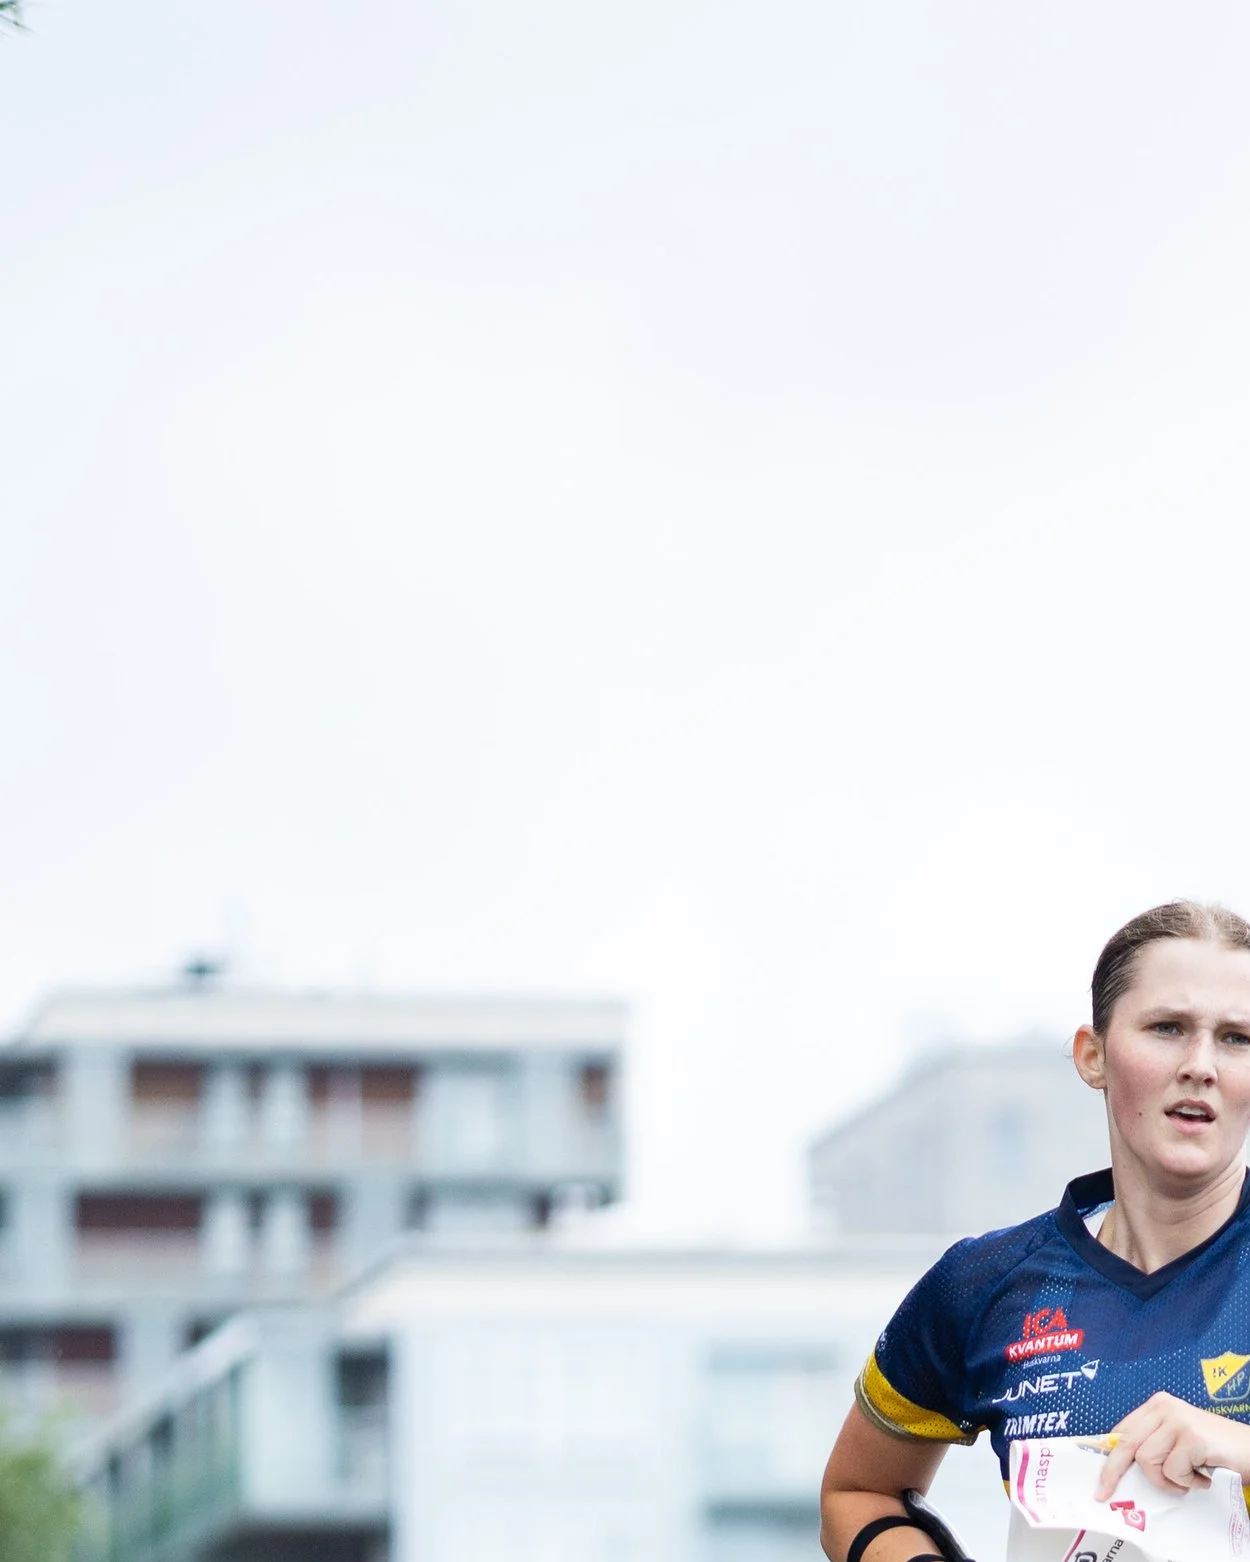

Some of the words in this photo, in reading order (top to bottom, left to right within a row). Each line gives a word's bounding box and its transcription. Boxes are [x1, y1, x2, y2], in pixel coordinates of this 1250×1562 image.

[1023, 1306, 1067, 1338] ICA
[1009, 1333, 1078, 1358] KVANTUM
[992, 1371, 1081, 1403] JUNET
[1004, 1410, 1070, 1435] TRIMTEX
